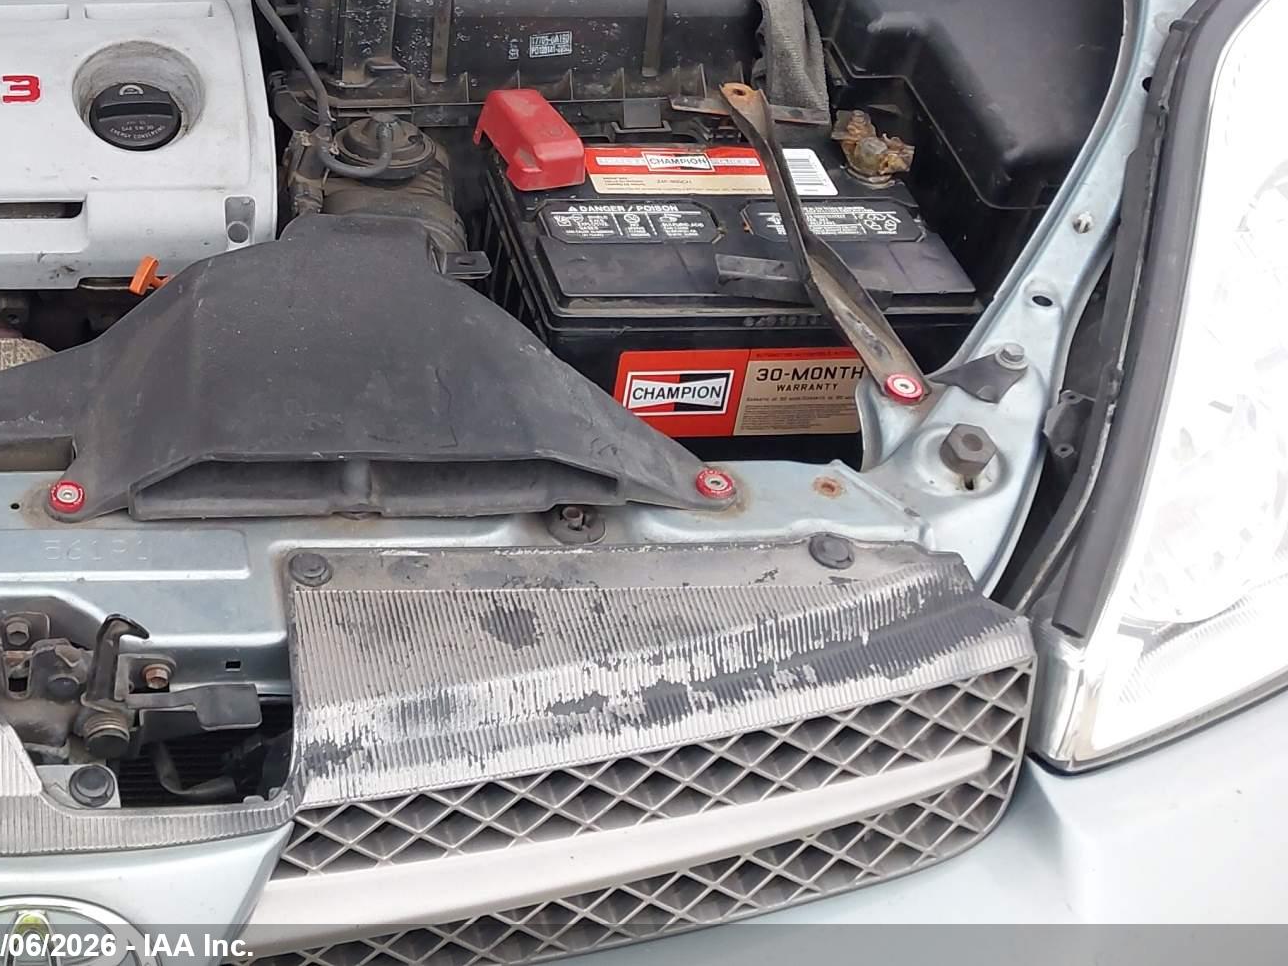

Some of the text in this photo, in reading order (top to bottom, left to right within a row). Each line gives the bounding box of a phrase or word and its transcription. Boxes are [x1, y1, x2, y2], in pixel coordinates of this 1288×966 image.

[649, 157, 707, 166] CHAMPION
[755, 365, 865, 382] 30-MONTH
[631, 384, 723, 401] CHAMPION
[775, 382, 839, 393] WARRANTY
